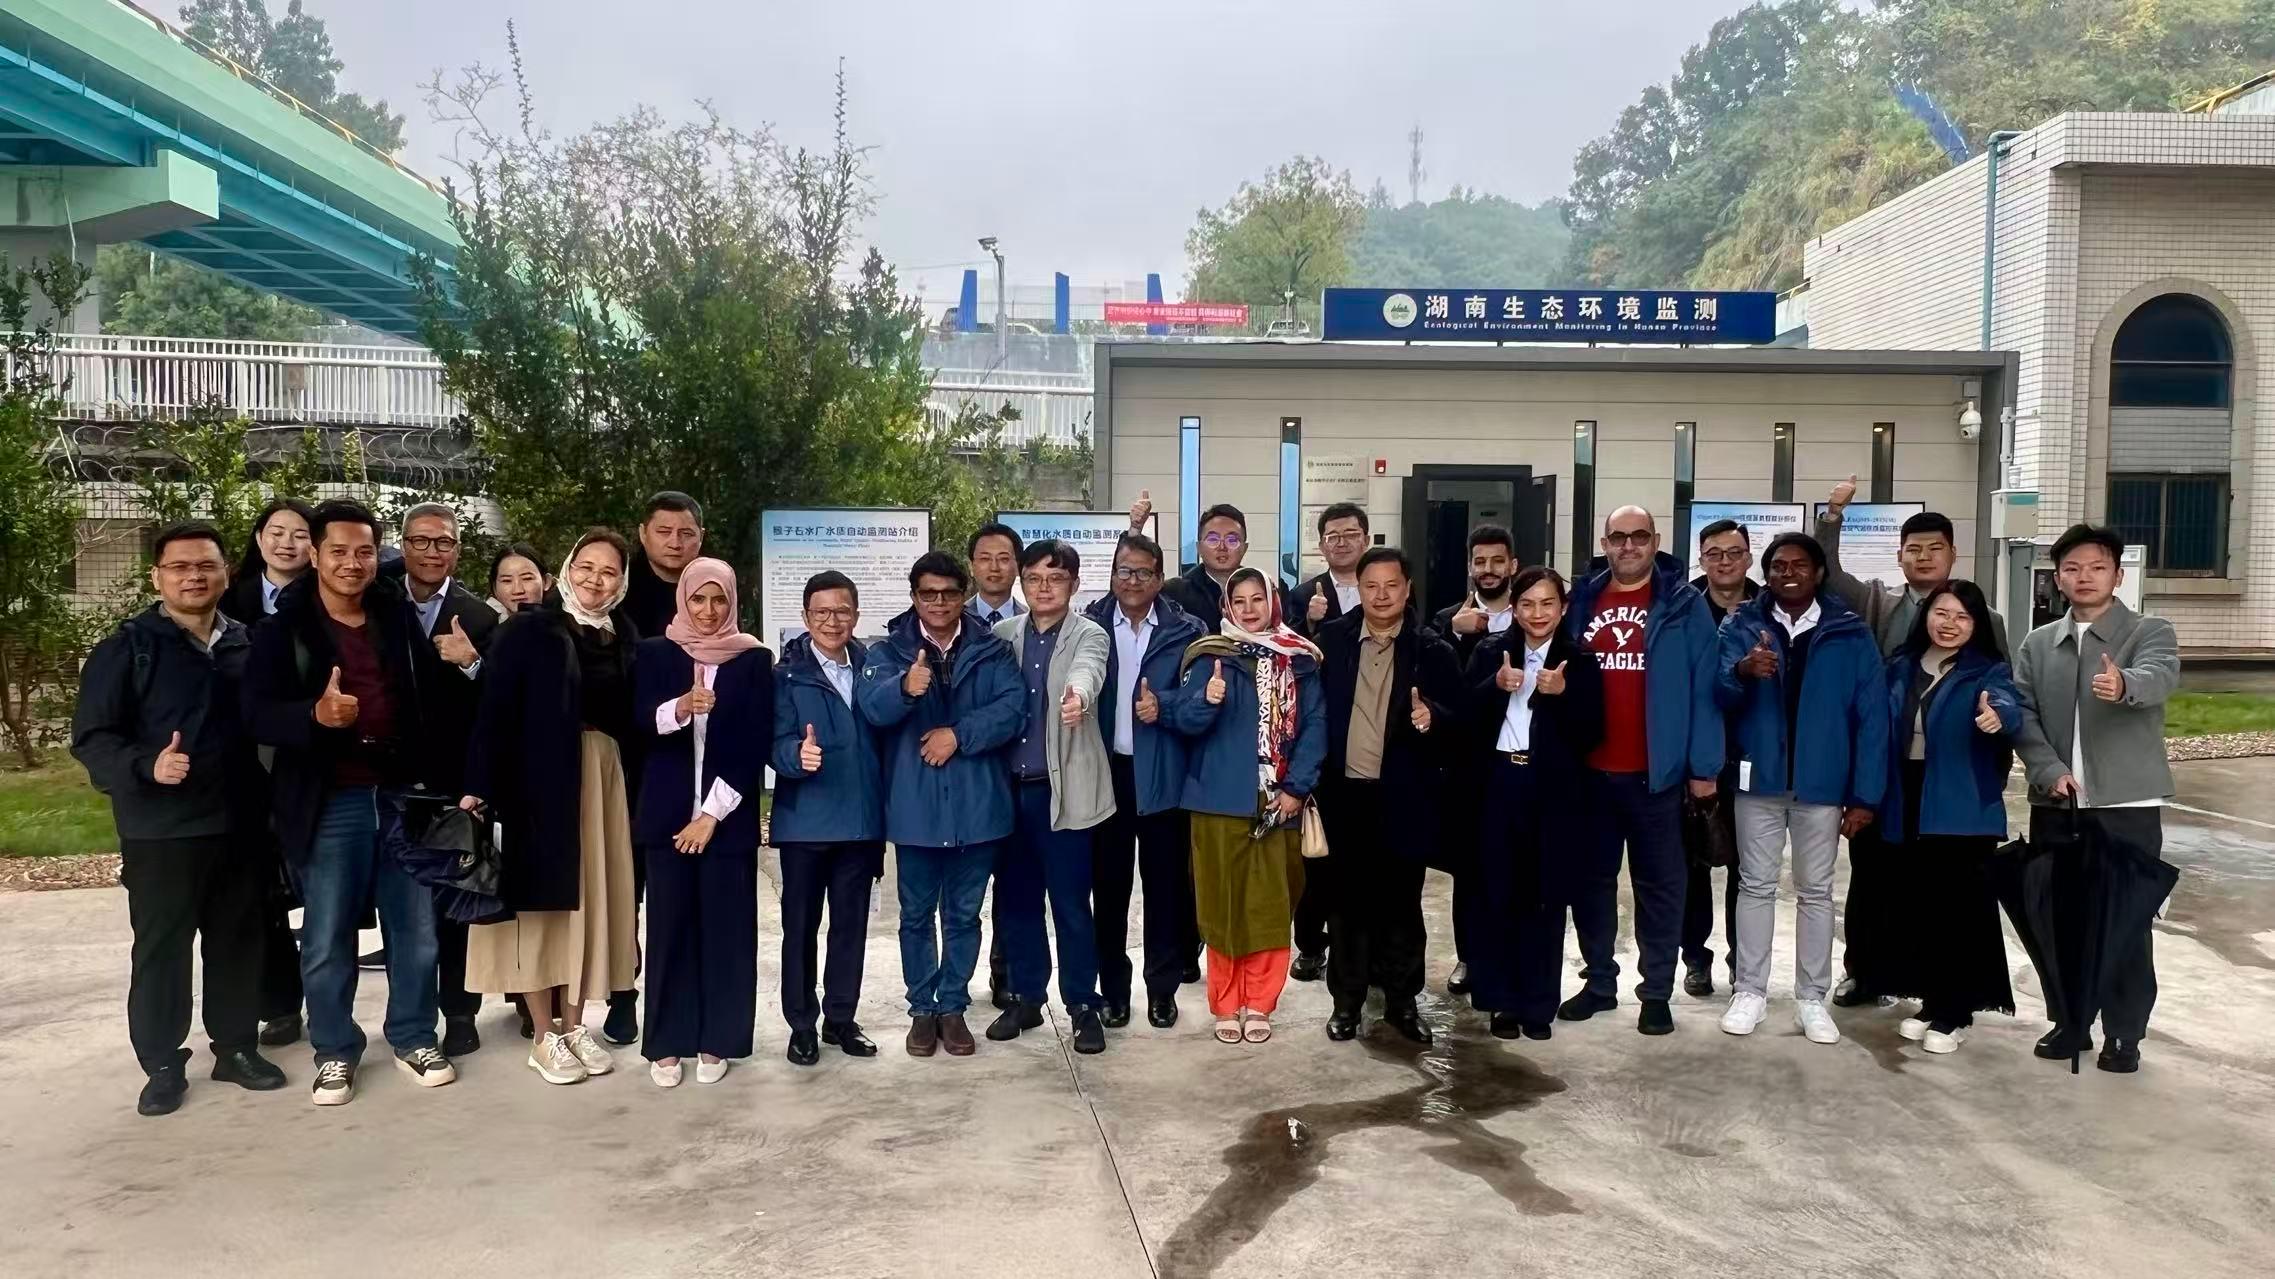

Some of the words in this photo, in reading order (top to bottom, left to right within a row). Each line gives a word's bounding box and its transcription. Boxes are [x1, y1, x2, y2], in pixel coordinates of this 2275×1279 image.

[1425, 295, 1717, 321] 湖南生态环境监测
[1424, 321, 1478, 330] Ecological
[1484, 321, 1549, 330] Environment
[1555, 322, 1612, 332] Monitoring
[1672, 323, 1717, 332] Province
[1583, 606, 1648, 642] AMERIC
